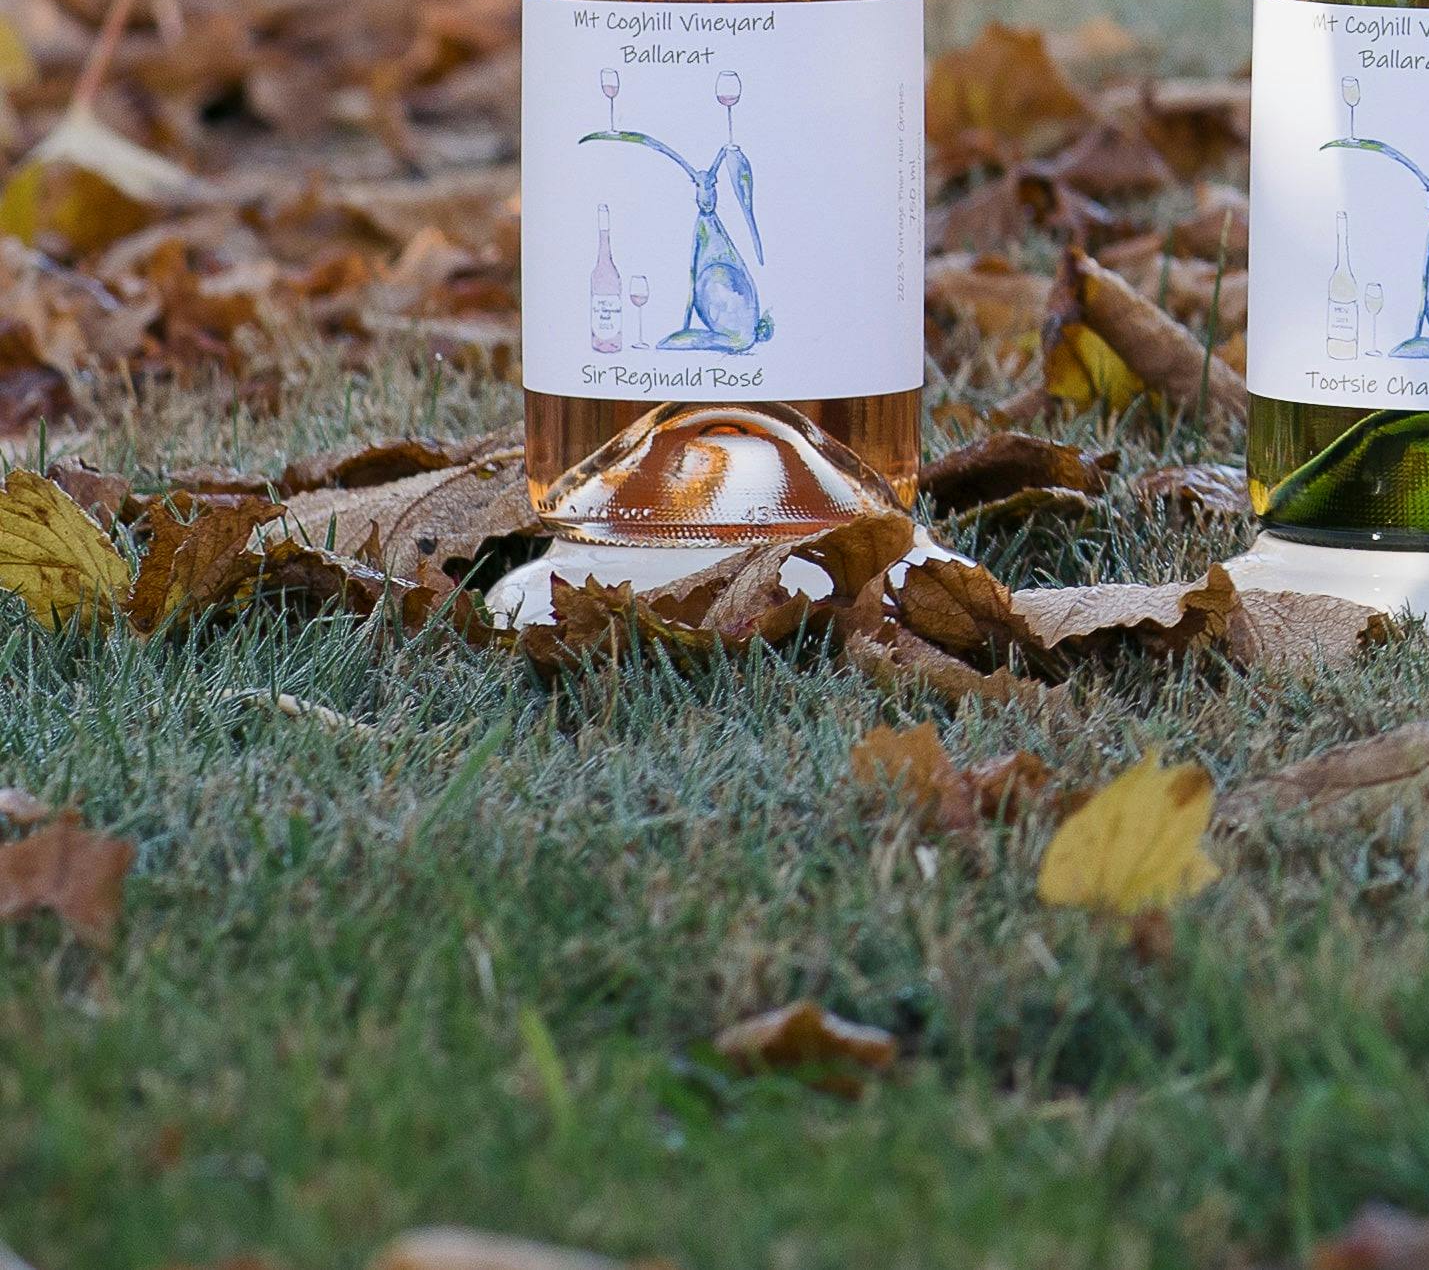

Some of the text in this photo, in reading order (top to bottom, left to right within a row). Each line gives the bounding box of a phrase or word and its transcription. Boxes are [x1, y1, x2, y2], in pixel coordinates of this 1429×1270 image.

[573, 9, 775, 38] Mt Coghill Vineyard
[1313, 14, 1339, 33] Mt
[1345, 15, 1411, 43] Coghill
[619, 44, 715, 65] Ballarat
[581, 364, 764, 394] Sir Reginald Rosé
[1304, 370, 1379, 394] Tootsie
